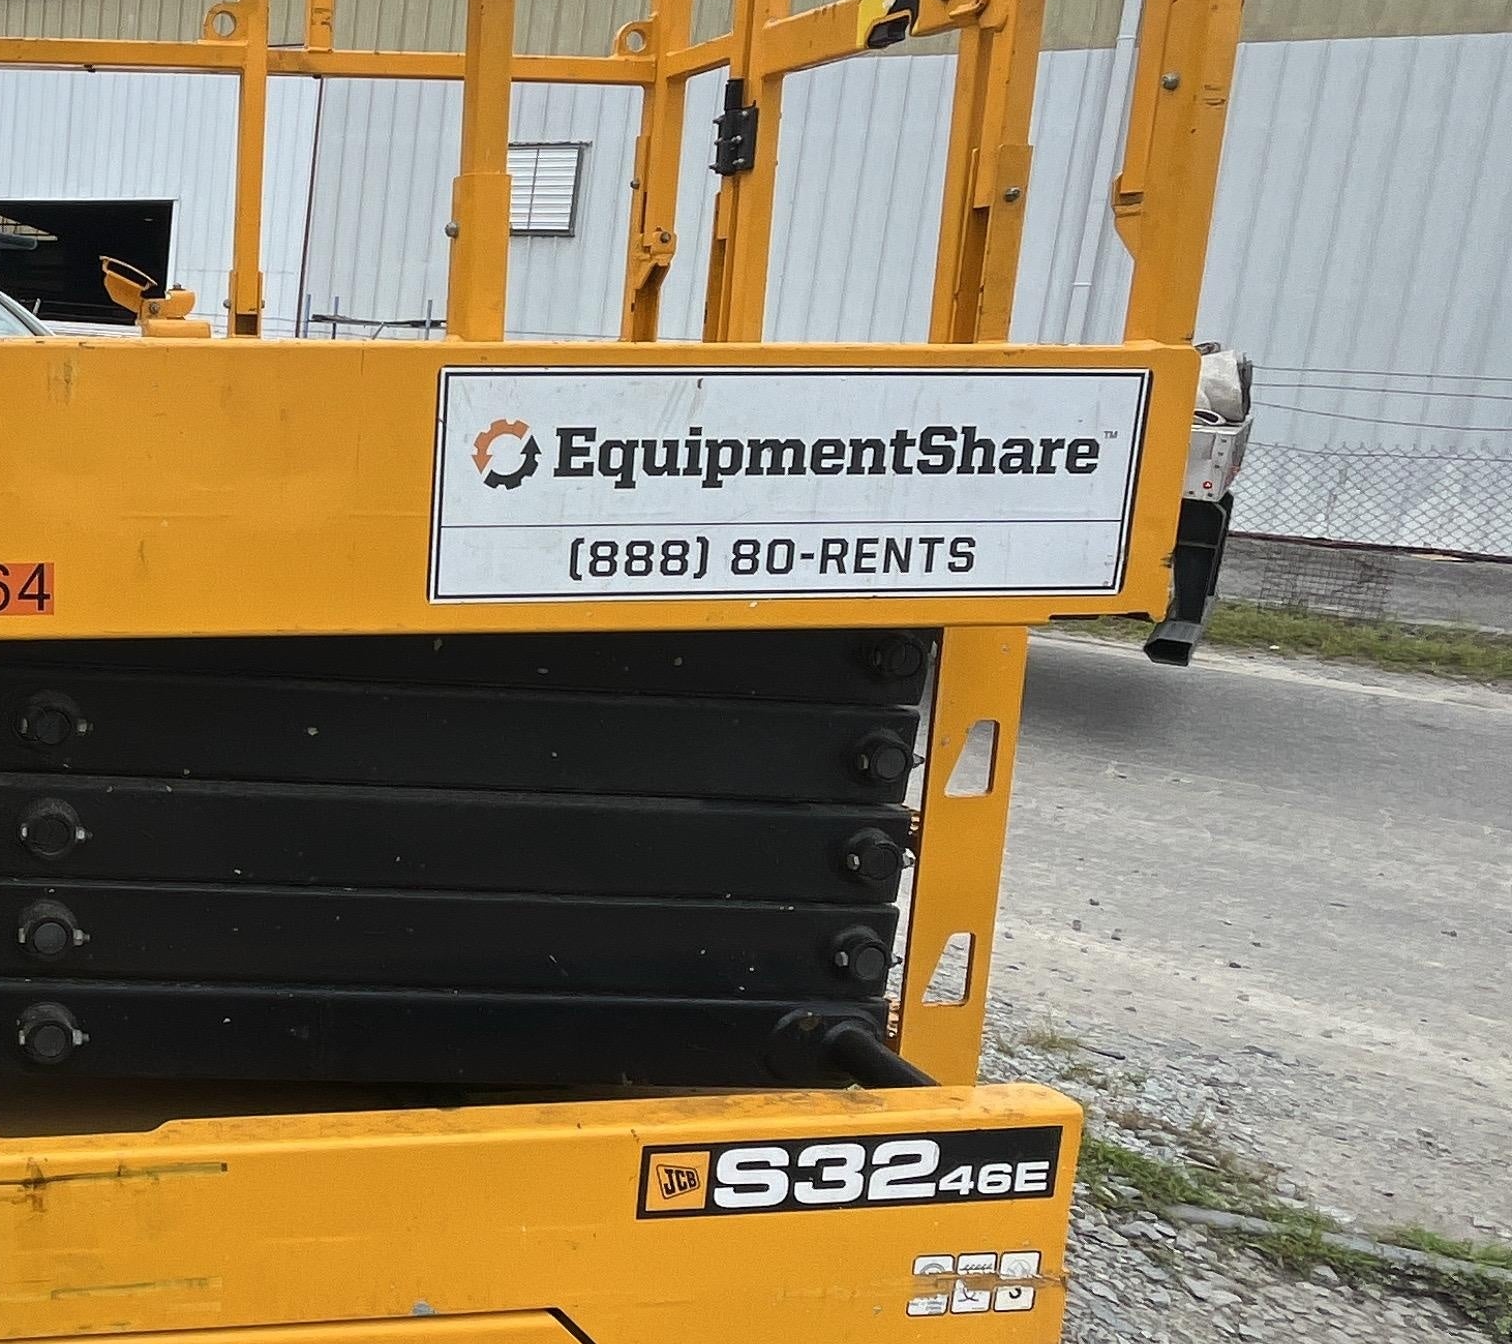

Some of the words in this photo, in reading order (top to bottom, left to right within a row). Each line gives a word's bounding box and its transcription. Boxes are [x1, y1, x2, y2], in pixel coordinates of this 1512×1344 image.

[553, 425, 1100, 490] EquipmentShare
[569, 536, 710, 581] (888)
[730, 536, 977, 576] 80-RENTS
[661, 1165, 699, 1196] JCB
